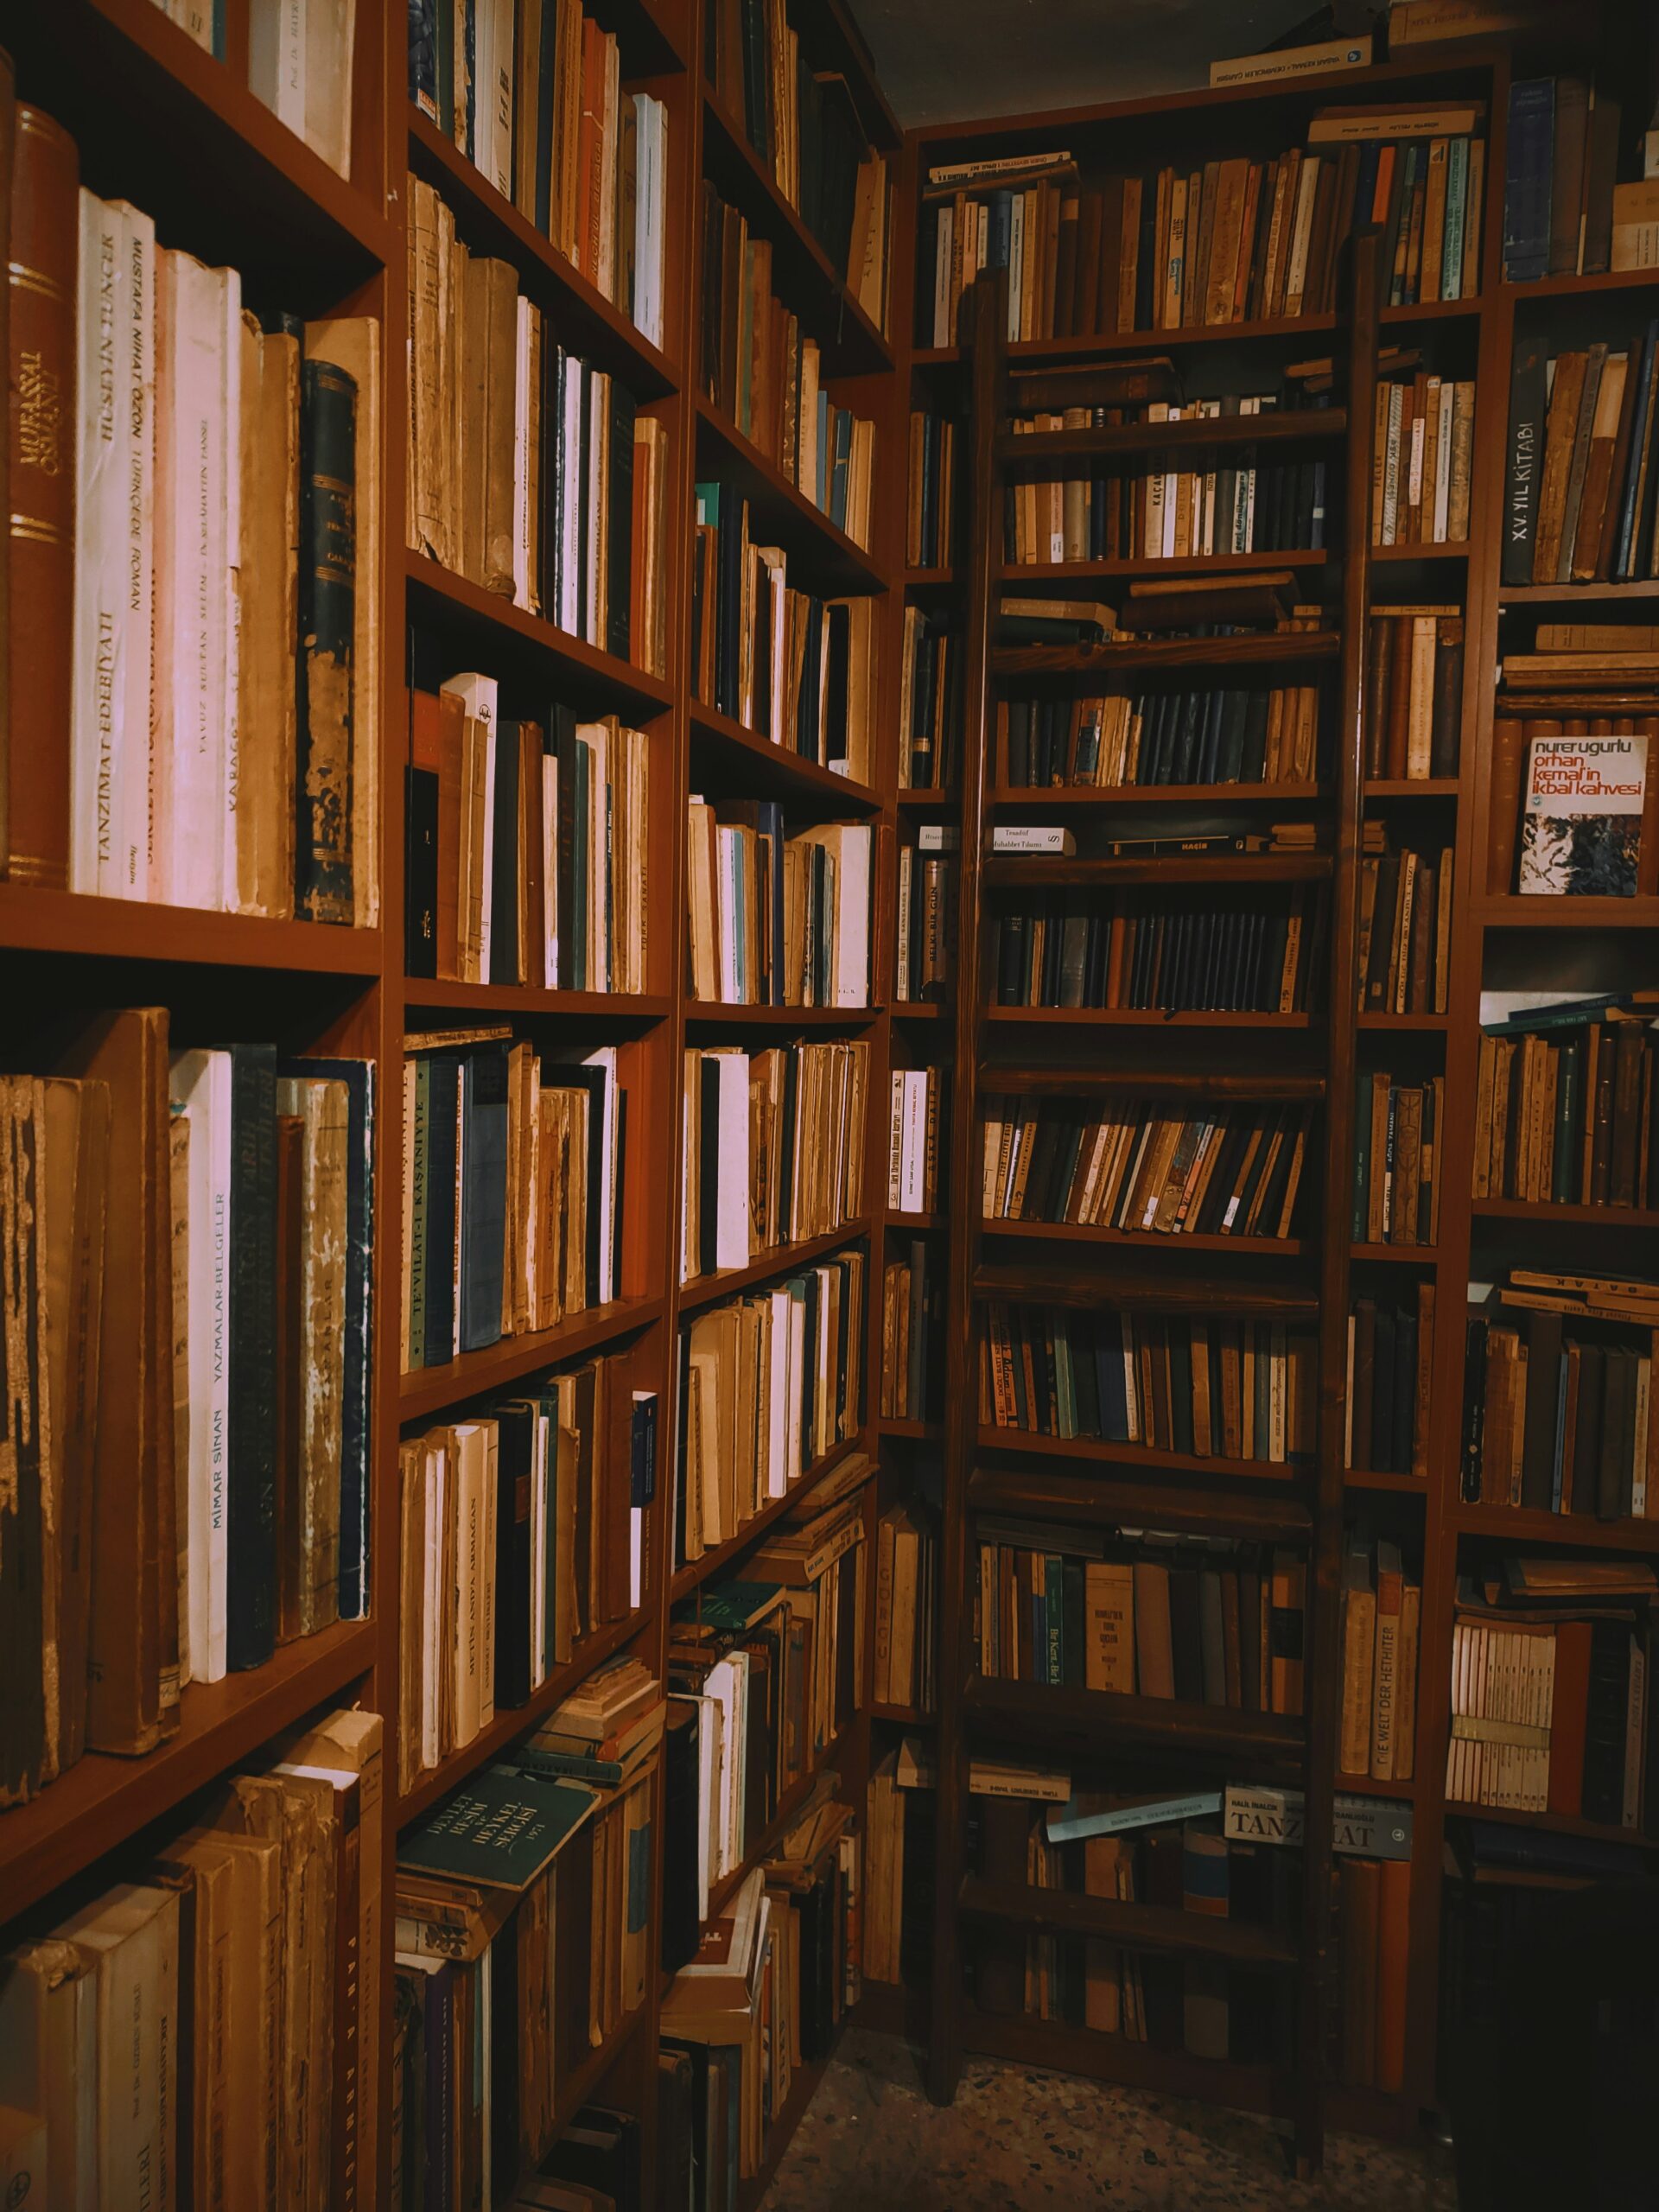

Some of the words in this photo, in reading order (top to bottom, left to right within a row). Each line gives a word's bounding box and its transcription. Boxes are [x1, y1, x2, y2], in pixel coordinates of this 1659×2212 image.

[130, 238, 143, 321] MUSTAFA
[130, 327, 143, 380] NİHAT
[130, 386, 143, 439] ÖZÖN
[1511, 423, 1535, 481] KİTABI
[1511, 484, 1529, 512] YIL
[1511, 515, 1529, 542] XV.
[130, 548, 142, 611] ROMAN
[99, 610, 114, 733] EDEBİYATI
[200, 631, 209, 691] SULTAN
[199, 701, 209, 753] YAVUZ
[1535, 741, 1577, 753] nurer
[1534, 753, 1584, 767] orhan
[98, 735, 112, 864] TANZİMAT
[1532, 781, 1572, 795] ikbal
[1576, 781, 1642, 796] kahvesi
[929, 887, 938, 910] GÜN
[929, 913, 938, 931] BİR
[929, 933, 939, 962] BELKİ
[213, 1193, 226, 1383] YAZMALAR-BELGELER
[211, 1409, 223, 1465] SİNAN
[211, 1471, 223, 1529] MİMAR
[467, 1625, 477, 1677] METİN
[1049, 1628, 1059, 1641] Bir
[1380, 1626, 1394, 1683] HETHITER
[1378, 1686, 1391, 1708] DER
[1377, 1712, 1390, 1742] WELT
[426, 1794, 473, 1834] DEVLET
[449, 1802, 487, 1835] RESİM
[472, 1802, 522, 1844] HEYKEL
[1230, 1800, 1250, 1809] HALİL
[492, 1806, 538, 1848] SERGİSİ
